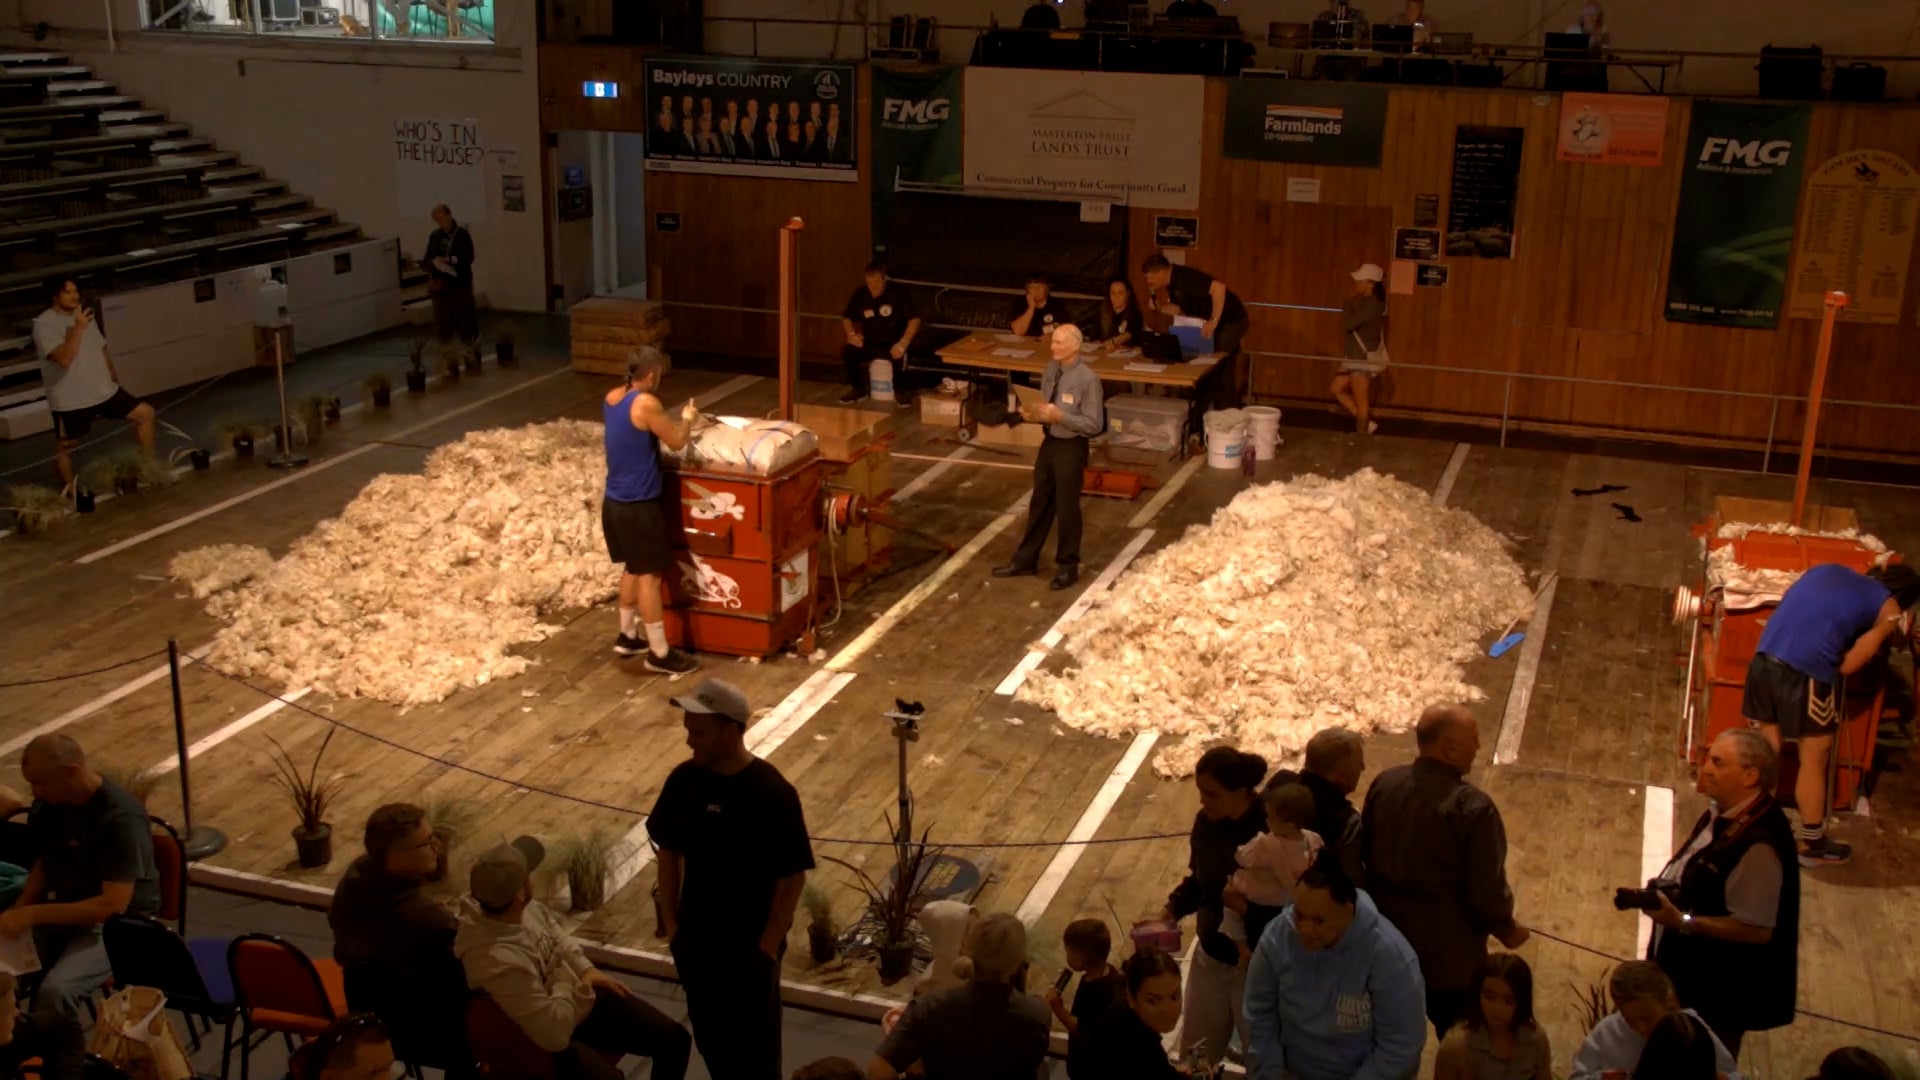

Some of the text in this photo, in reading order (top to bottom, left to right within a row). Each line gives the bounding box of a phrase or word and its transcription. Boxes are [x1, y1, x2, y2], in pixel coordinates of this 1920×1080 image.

[653, 69, 714, 88] Bayleys
[717, 73, 793, 89] COUNTRY
[883, 97, 950, 123] FMG
[394, 120, 476, 146] WHO'S IN
[1032, 129, 1096, 140] MASTERTON
[1265, 117, 1343, 136] Farmlands
[1032, 141, 1129, 158] LANDS TRUST
[1699, 136, 1793, 168] FMG
[976, 172, 1034, 186] Commercial
[1036, 174, 1077, 190] Property
[1080, 178, 1095, 190] for
[1157, 182, 1187, 194] Good
